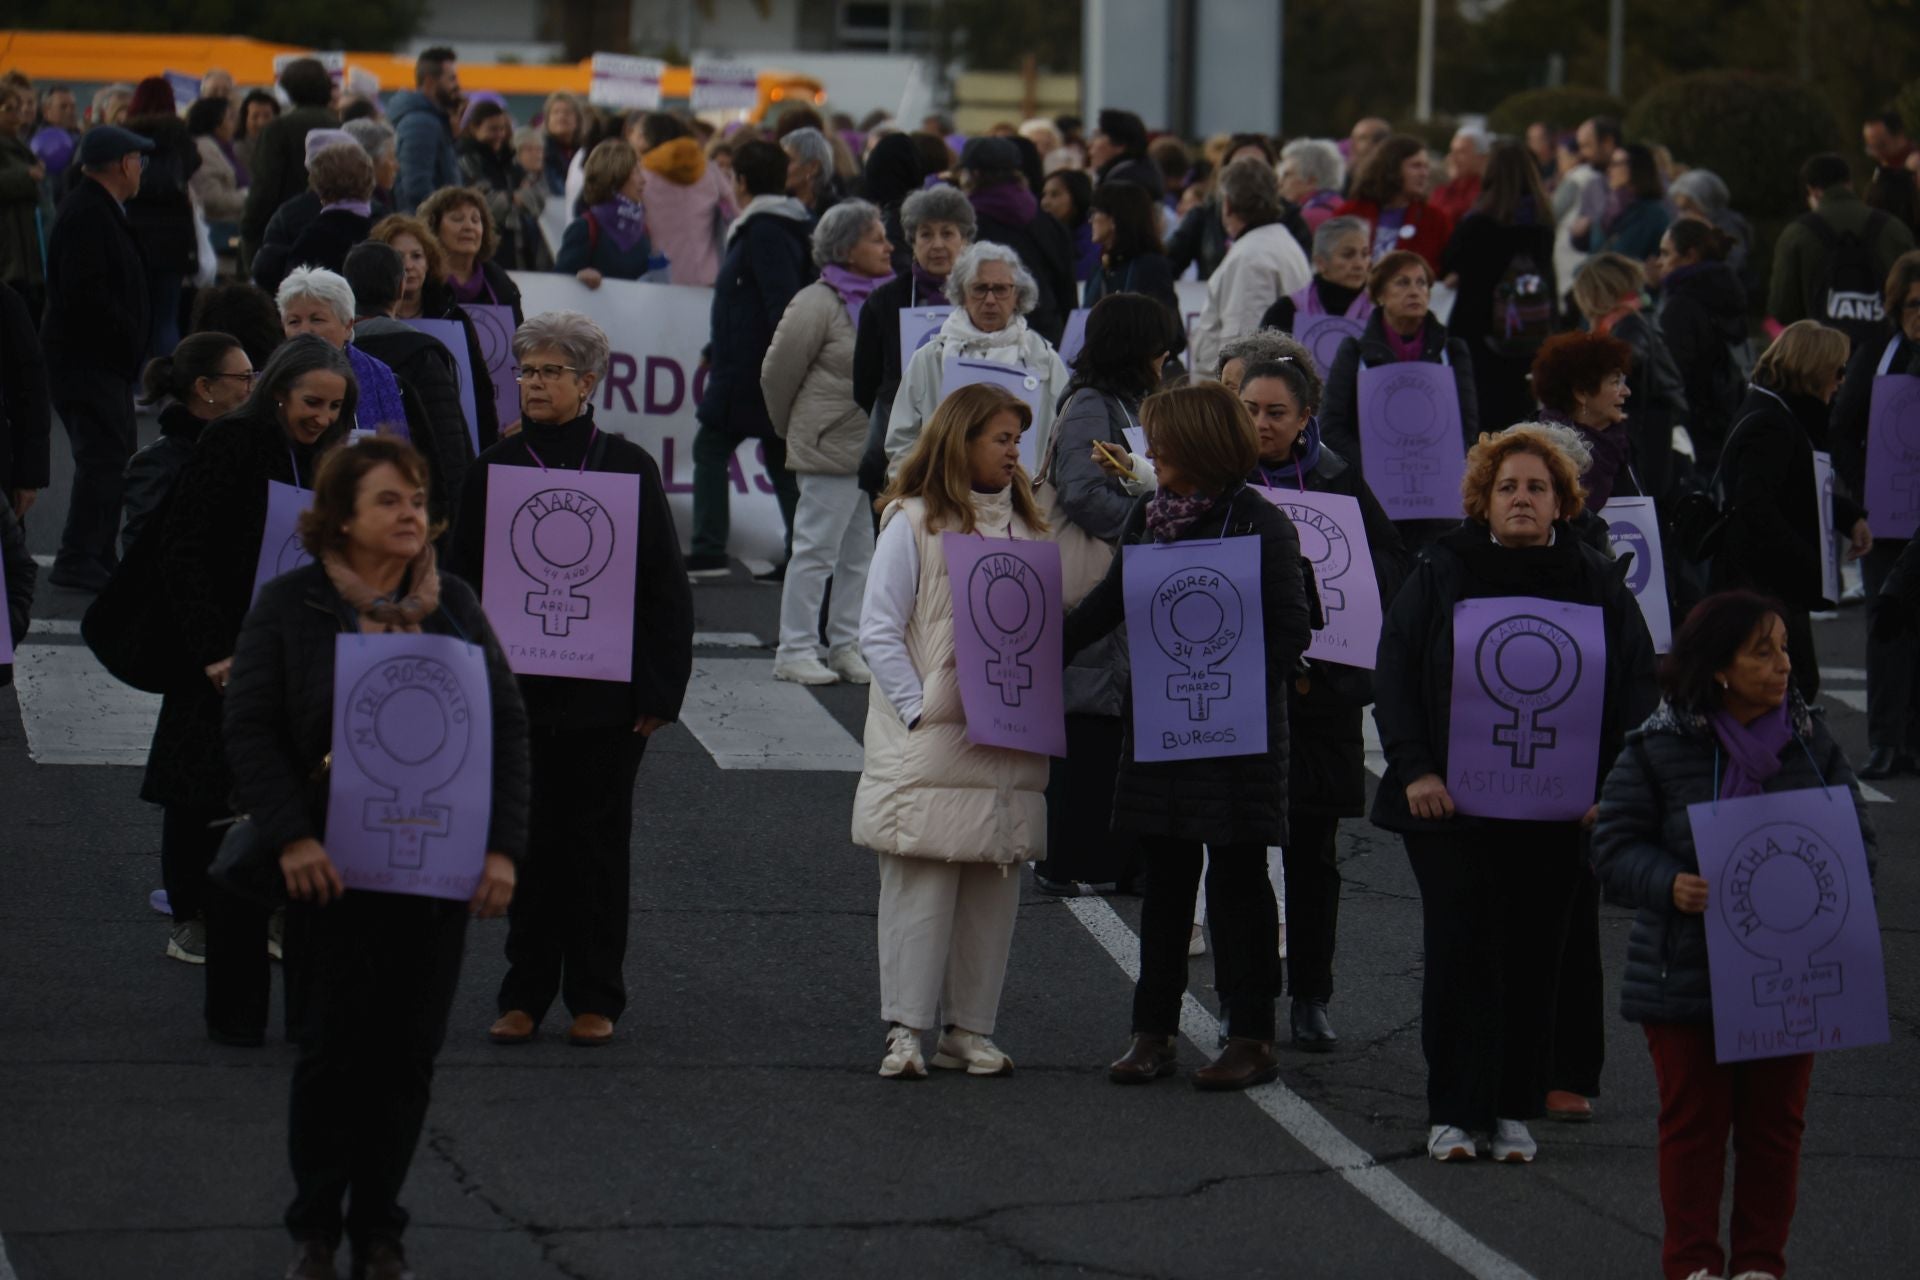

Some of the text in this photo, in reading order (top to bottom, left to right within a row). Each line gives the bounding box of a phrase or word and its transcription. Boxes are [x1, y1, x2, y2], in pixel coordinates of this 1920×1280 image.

[1827, 288, 1887, 322] VANS
[527, 492, 598, 525] MARTA
[982, 557, 1027, 585] NADIA
[1160, 576, 1219, 606] ANDREA
[509, 644, 595, 662] TARRAGONA
[1173, 629, 1235, 658] 34 AÑOS
[382, 660, 466, 724] ROSARIO
[1177, 682, 1220, 693] MARZO
[1163, 728, 1236, 749] BURGOS
[1458, 771, 1564, 799] ASTURIAS
[1731, 836, 1838, 937] MARTHA ISABEL
[1738, 1028, 1841, 1053] MURCIA
